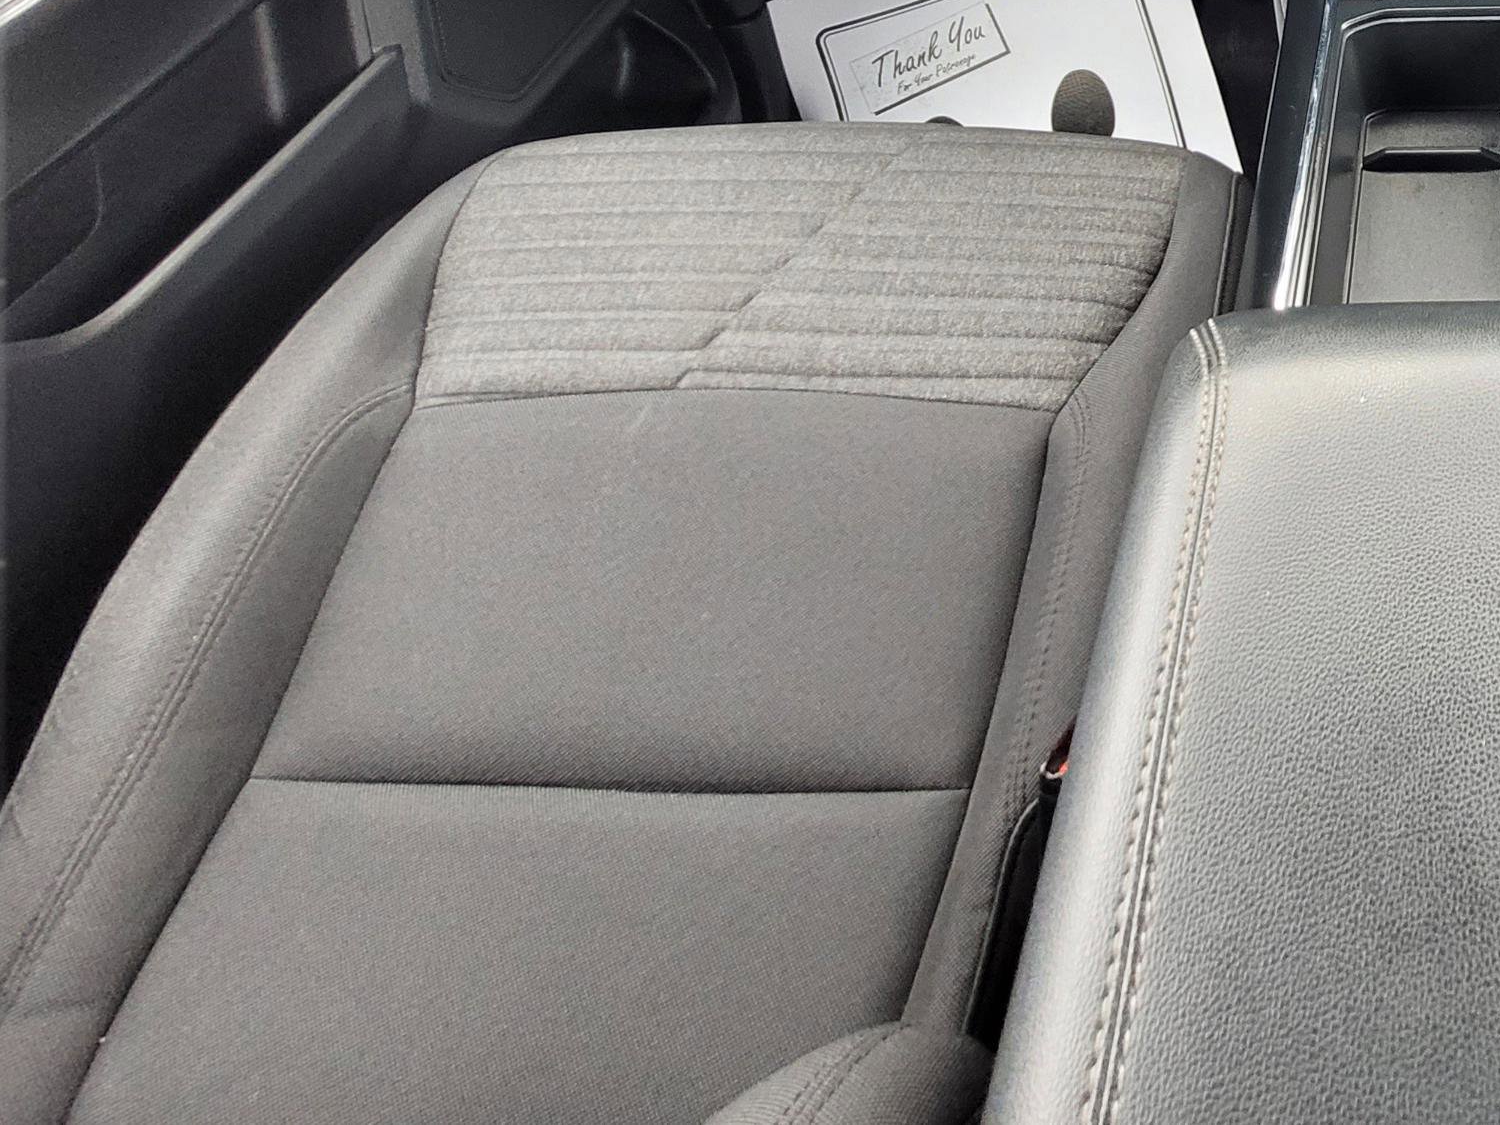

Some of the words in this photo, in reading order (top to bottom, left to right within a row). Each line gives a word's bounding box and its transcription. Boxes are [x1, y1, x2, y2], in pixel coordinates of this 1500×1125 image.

[871, 30, 943, 88] Thank
[948, 15, 986, 52] You
[897, 80, 912, 95] For
